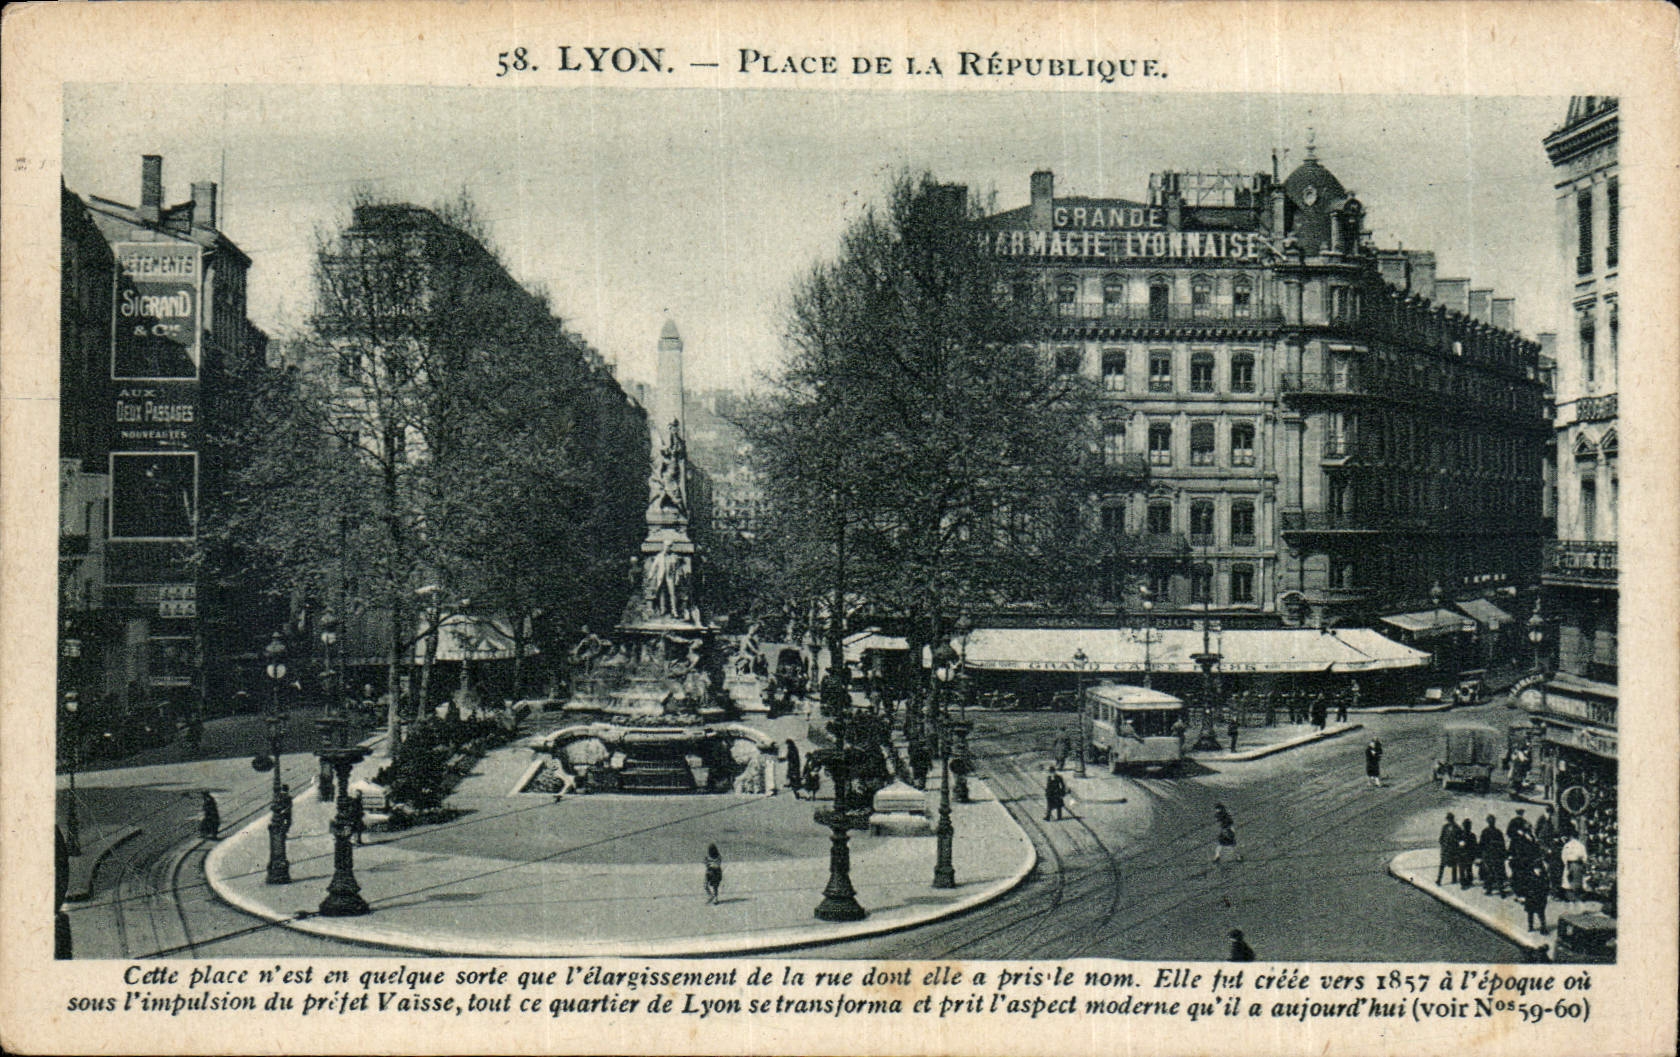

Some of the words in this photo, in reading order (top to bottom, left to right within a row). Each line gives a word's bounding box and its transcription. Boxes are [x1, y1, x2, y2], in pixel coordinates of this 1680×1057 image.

[1054, 207, 1162, 228] GRANDE
[1126, 231, 1258, 258] LYONNAISE
[119, 389, 155, 397] AUX
